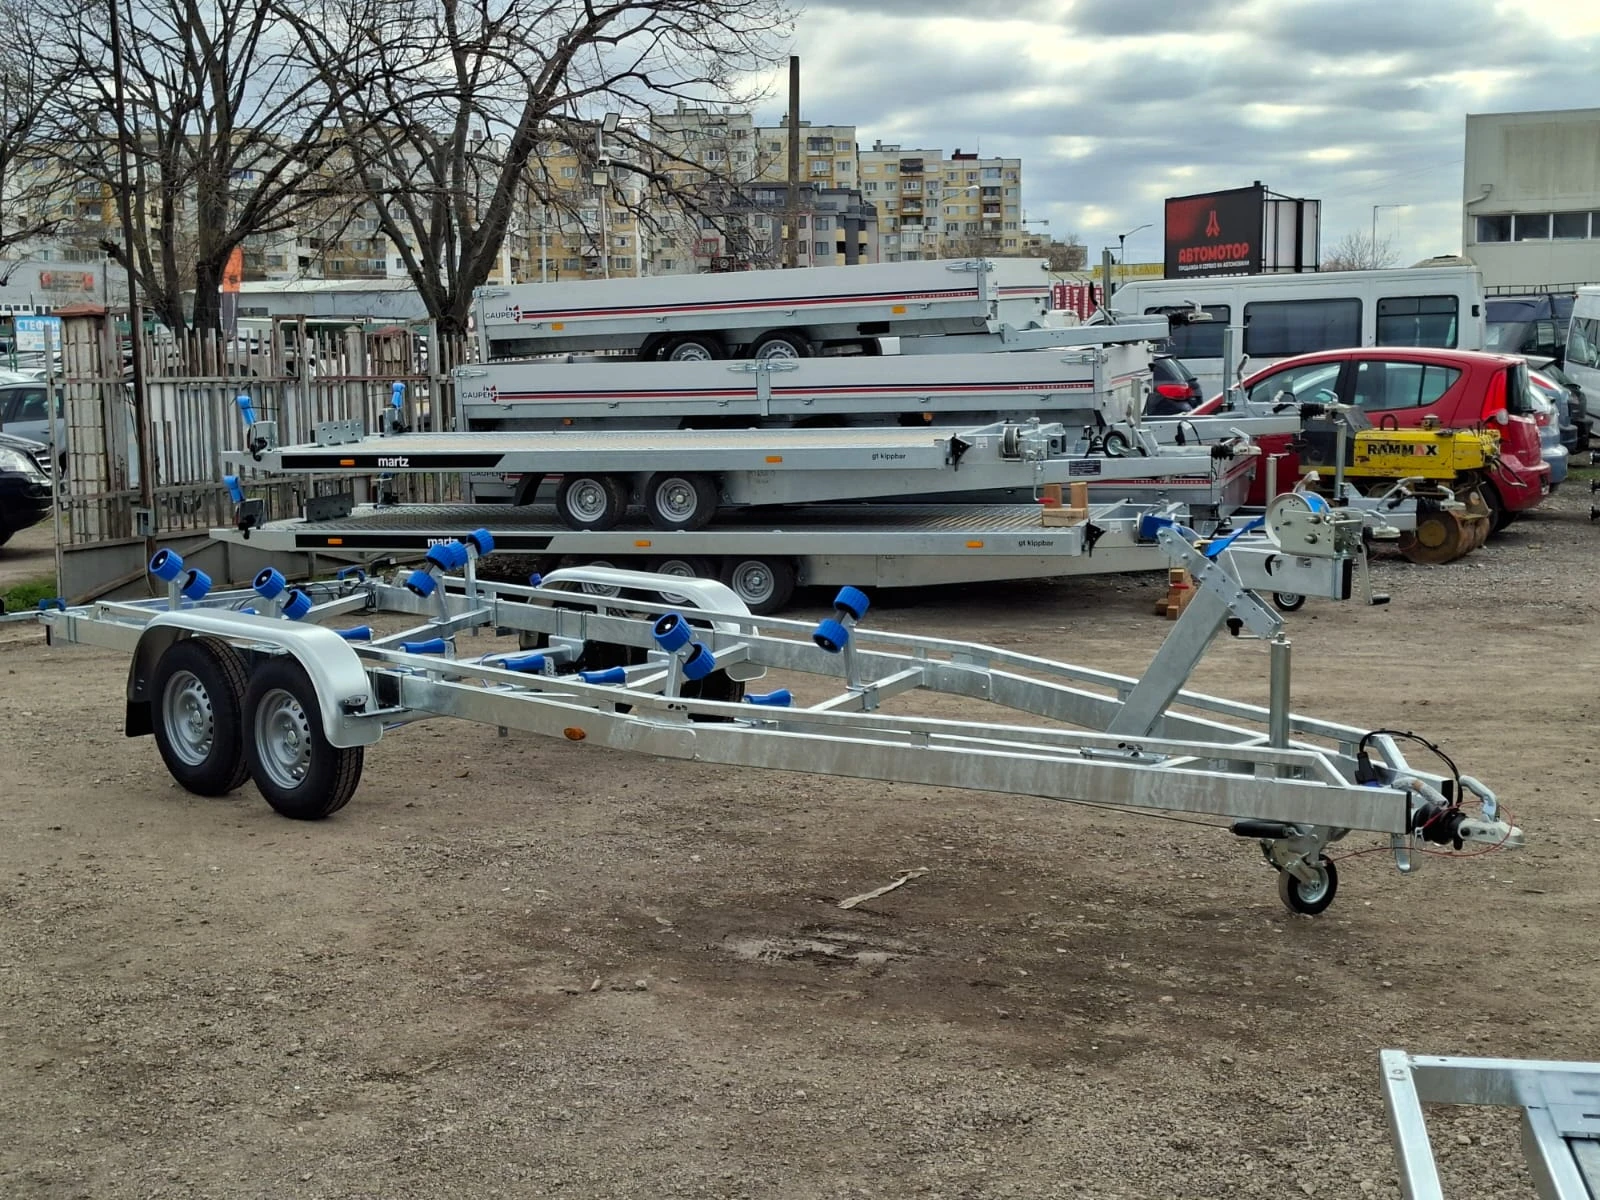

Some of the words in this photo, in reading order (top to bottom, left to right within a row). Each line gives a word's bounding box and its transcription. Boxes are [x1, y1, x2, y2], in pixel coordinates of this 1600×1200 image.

[1179, 243, 1249, 262] АВТОМОТОР
[16, 321, 60, 331] СТЕФН
[1367, 444, 1438, 456] RAMMAX
[378, 456, 410, 467] martz
